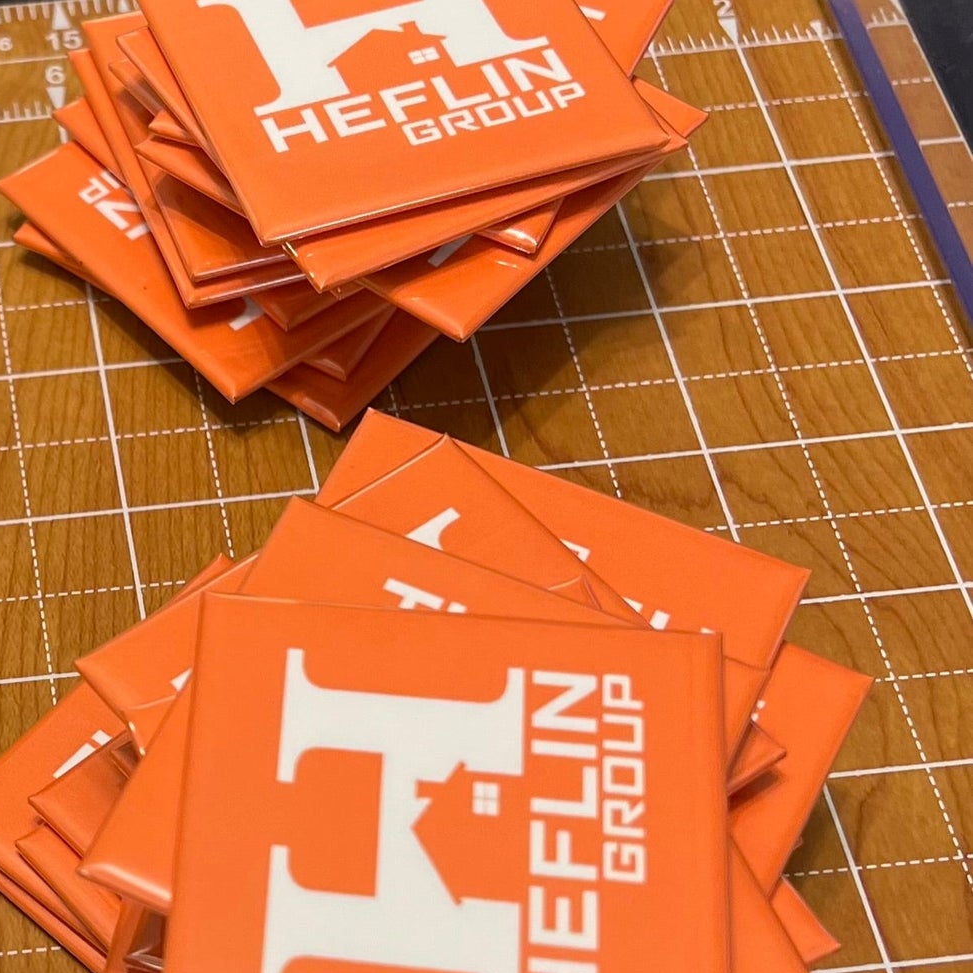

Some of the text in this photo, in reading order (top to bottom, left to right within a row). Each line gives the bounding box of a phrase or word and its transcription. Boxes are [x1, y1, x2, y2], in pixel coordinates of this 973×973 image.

[45, 30, 83, 51] 15
[45, 66, 66, 85] 6
[712, 0, 735, 17] 2
[261, 48, 573, 153] HEFLIN
[401, 81, 587, 146] GROUP
[602, 674, 646, 883] GROUP
